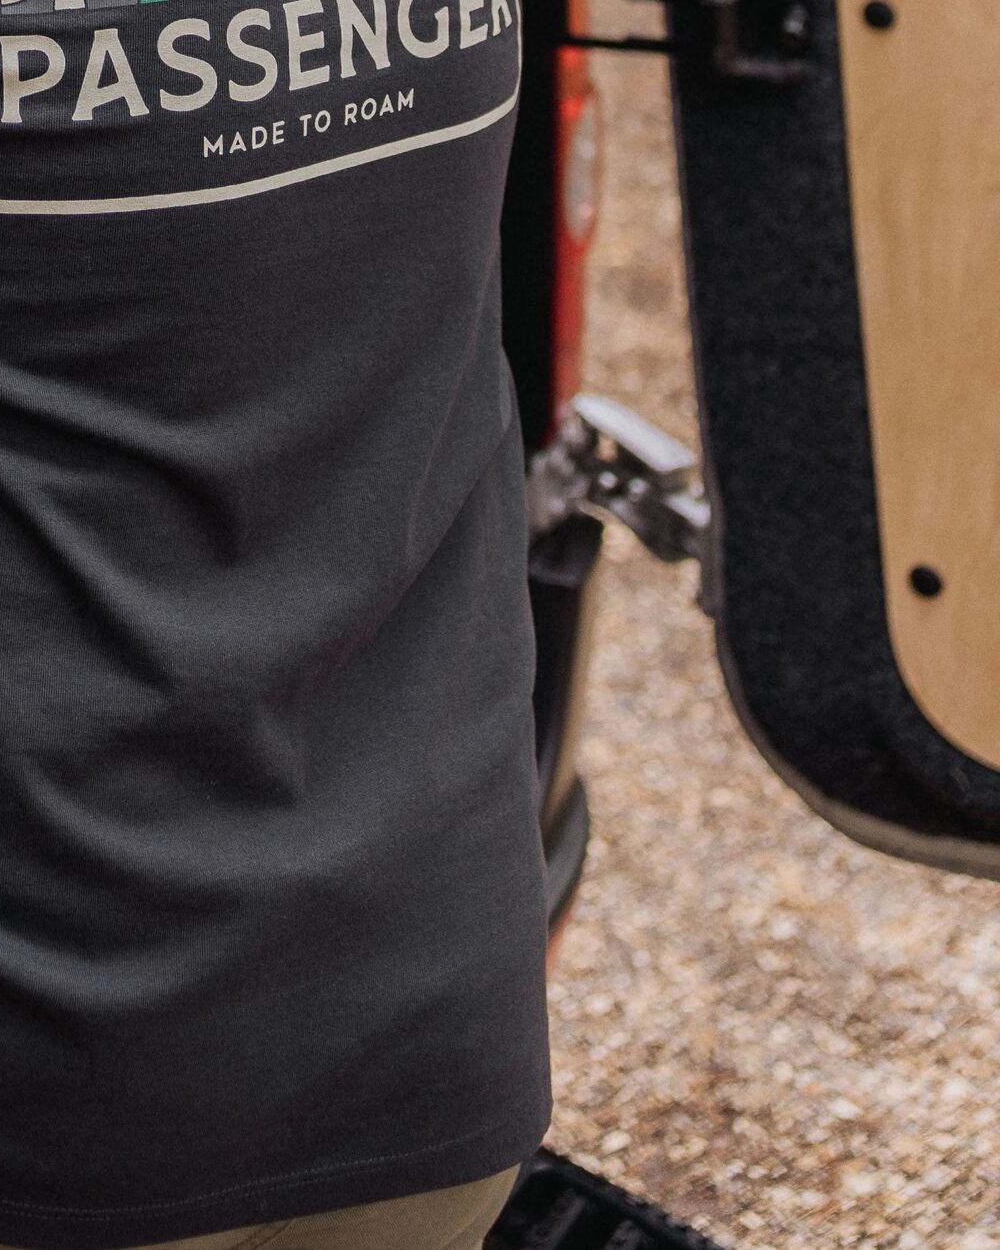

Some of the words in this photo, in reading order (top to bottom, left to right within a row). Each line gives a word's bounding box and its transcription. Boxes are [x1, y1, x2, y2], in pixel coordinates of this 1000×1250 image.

[203, 120, 286, 158] MADE
[299, 110, 331, 137] TO
[344, 88, 415, 125] ROAM
